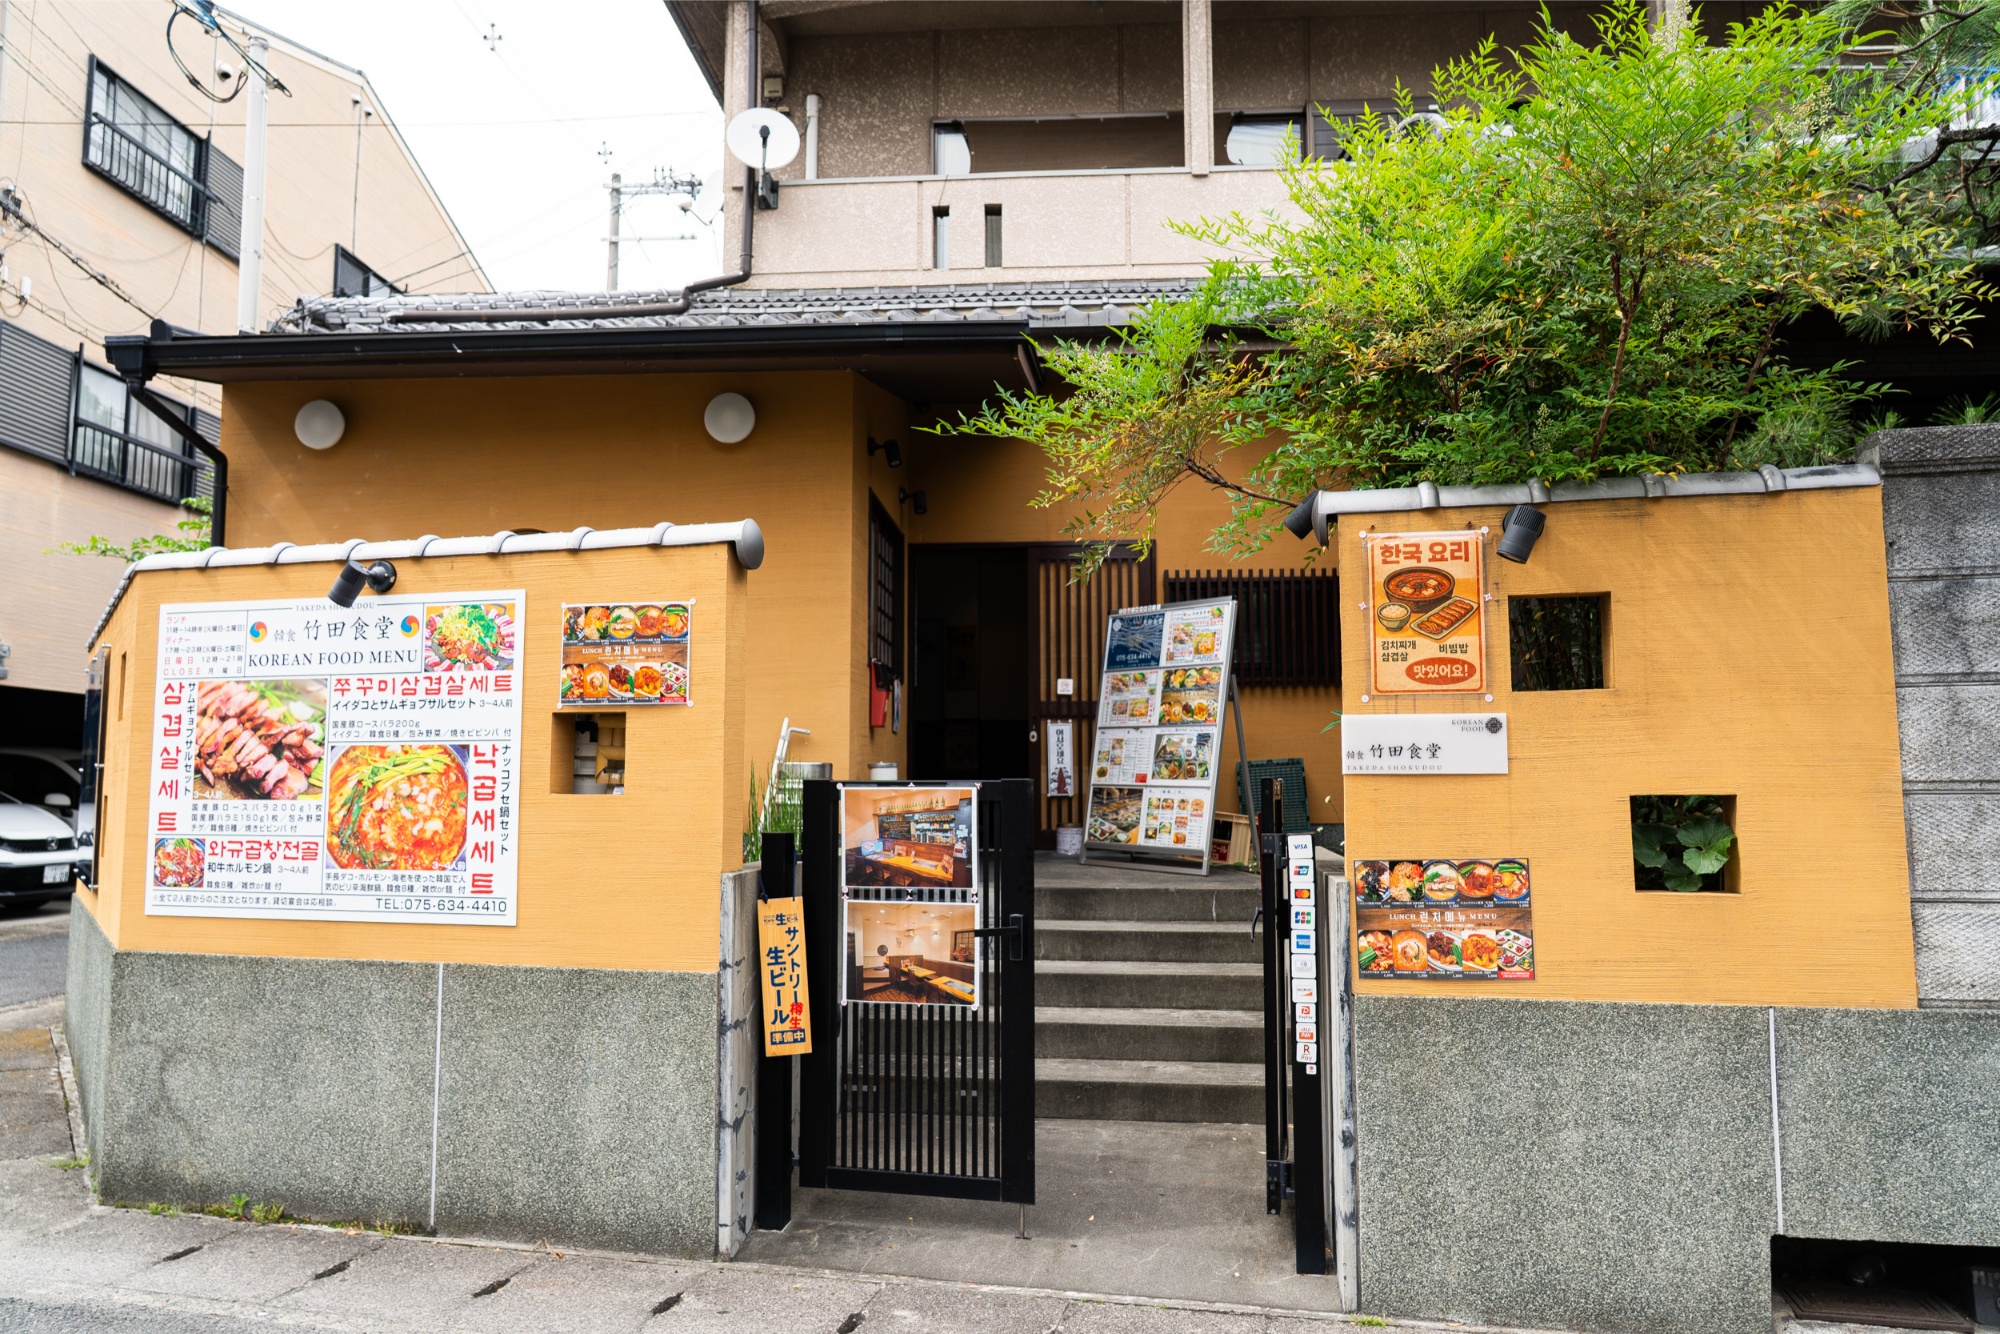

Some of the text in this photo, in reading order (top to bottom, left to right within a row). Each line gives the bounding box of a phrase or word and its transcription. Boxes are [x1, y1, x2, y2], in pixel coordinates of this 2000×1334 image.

[1380, 541, 1470, 565] 한국 요리
[295, 604, 326, 612] TAKEDA
[166, 616, 186, 624] ランチ
[303, 615, 394, 642] 竹田食堂
[166, 636, 191, 644] ディナー
[1381, 640, 1469, 654] 김치찌개 비빔밥
[164, 656, 194, 666] 日曜日
[248, 650, 418, 667] KOREAN FOOD MENU
[1381, 652, 1409, 662] 삼겹살
[163, 666, 242, 676] CLOSE 月曜日
[1413, 664, 1469, 679] 맛있어요!
[333, 674, 513, 698] 쭈꾸미삼겹살세트
[156, 681, 186, 832] 삼겹살세트
[1370, 742, 1442, 760] 竹田食堂
[470, 743, 500, 895] 낙곱새세트
[208, 839, 319, 861] 와규곱창전골
[207, 862, 272, 874] 和牛ホルモン鍋
[376, 898, 507, 912] TEL:075-634-4410
[1419, 911, 1467, 923] 런치메뉴
[784, 926, 801, 1004] サントリー
[766, 946, 790, 1026] 生ビール
[772, 1030, 806, 1045] 準備中
[1304, 1044, 1310, 1054] R
